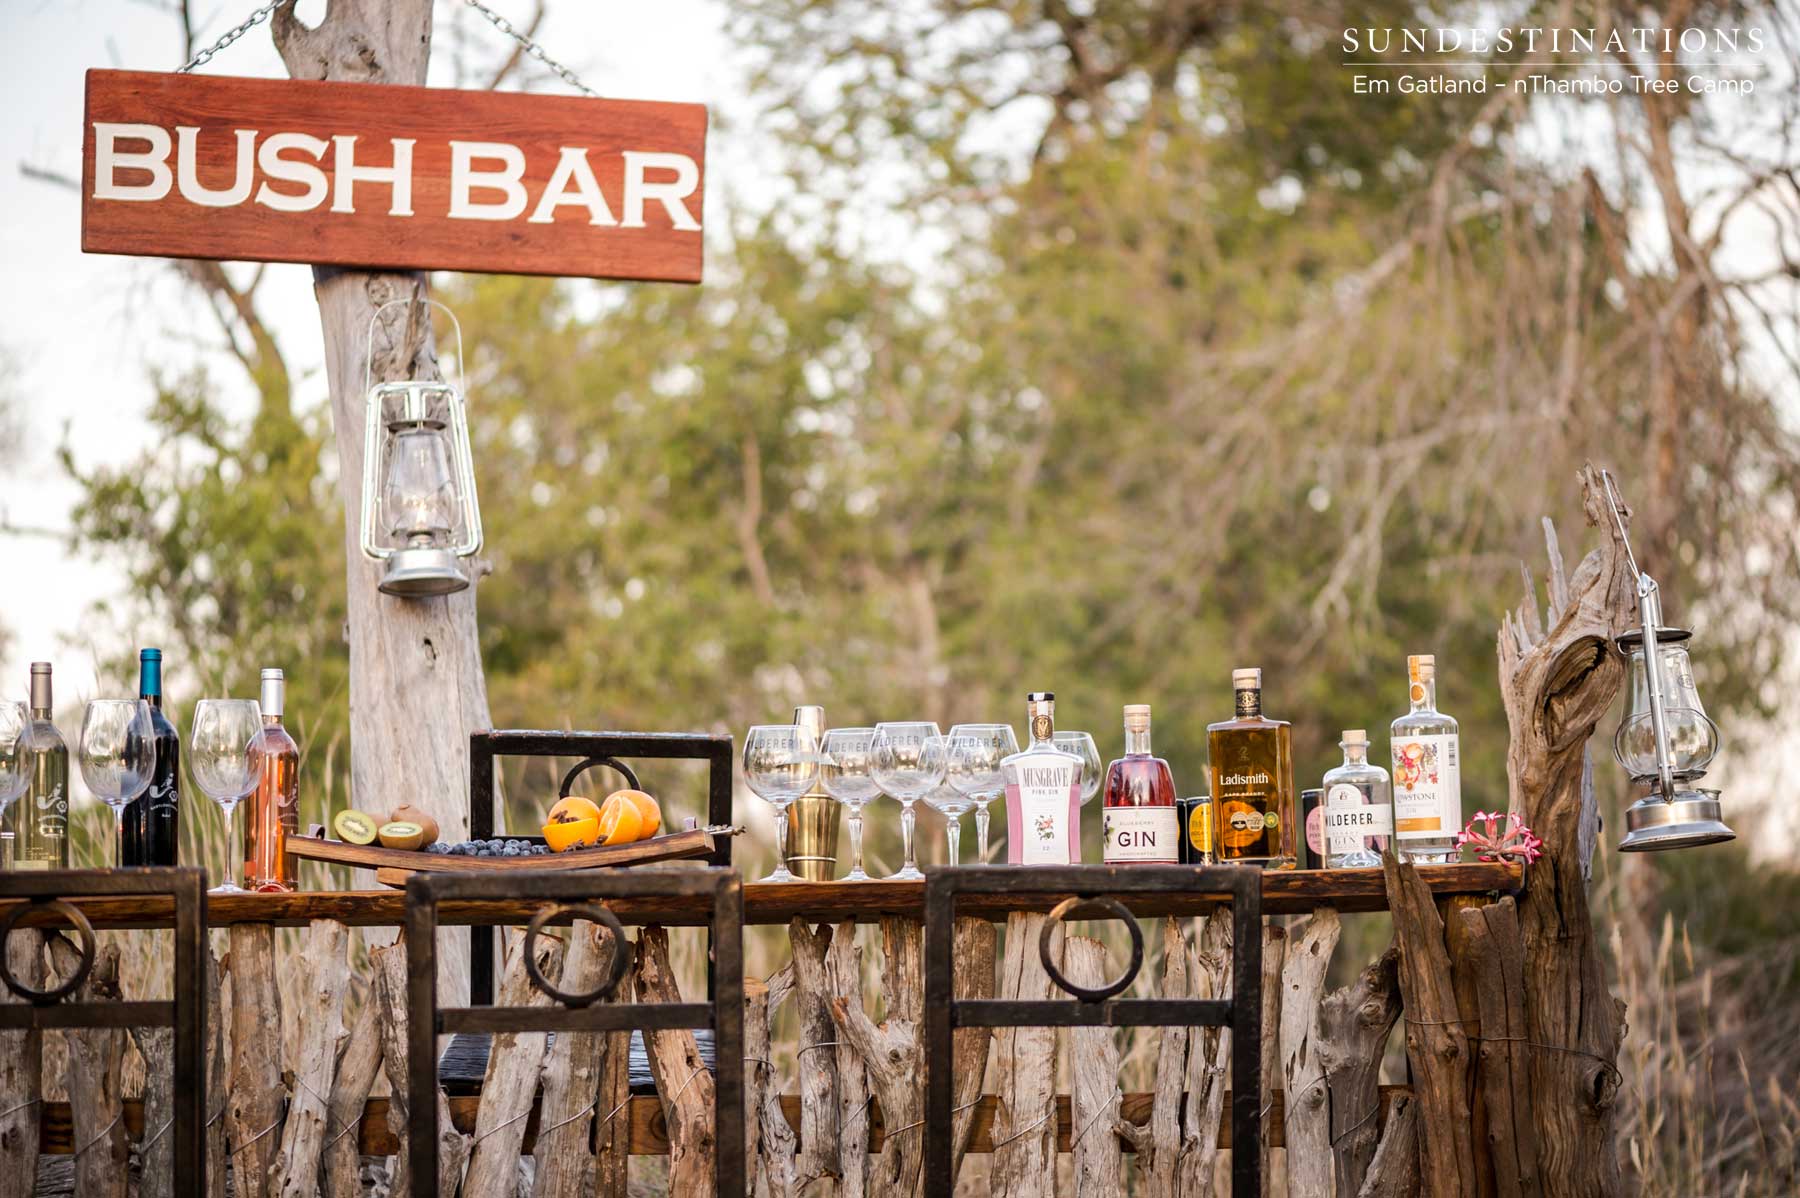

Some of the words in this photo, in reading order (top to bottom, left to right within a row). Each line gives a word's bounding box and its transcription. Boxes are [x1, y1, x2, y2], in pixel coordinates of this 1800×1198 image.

[92, 121, 417, 217] BUSH
[447, 140, 703, 231] BAR
[1022, 768, 1069, 787] MUSGRAVE
[1220, 773, 1269, 785] Ladismith
[1118, 831, 1155, 847] GIN
